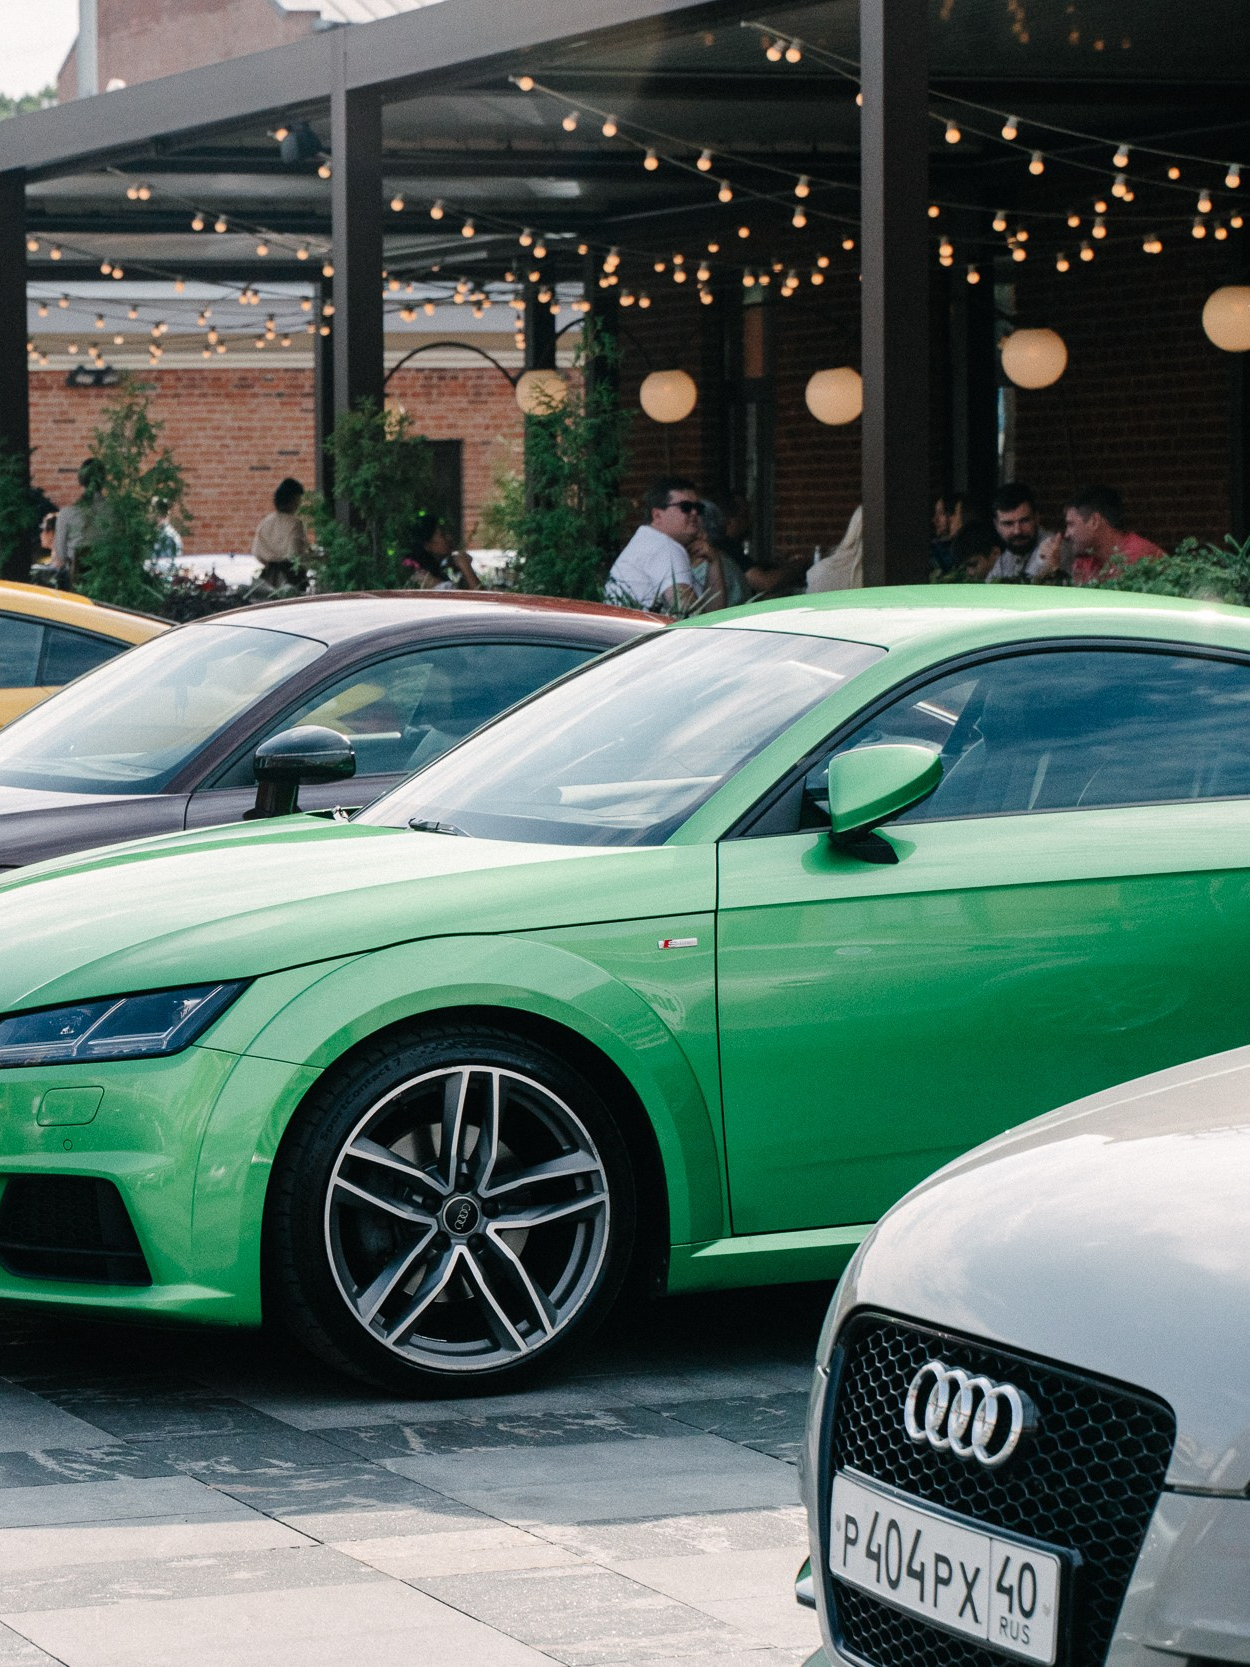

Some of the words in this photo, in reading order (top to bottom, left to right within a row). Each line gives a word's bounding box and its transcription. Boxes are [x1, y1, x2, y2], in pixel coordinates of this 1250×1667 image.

[320, 1064, 392, 1141] SportContact
[996, 1555, 1037, 1619] 40
[999, 1616, 1030, 1645] RUS
